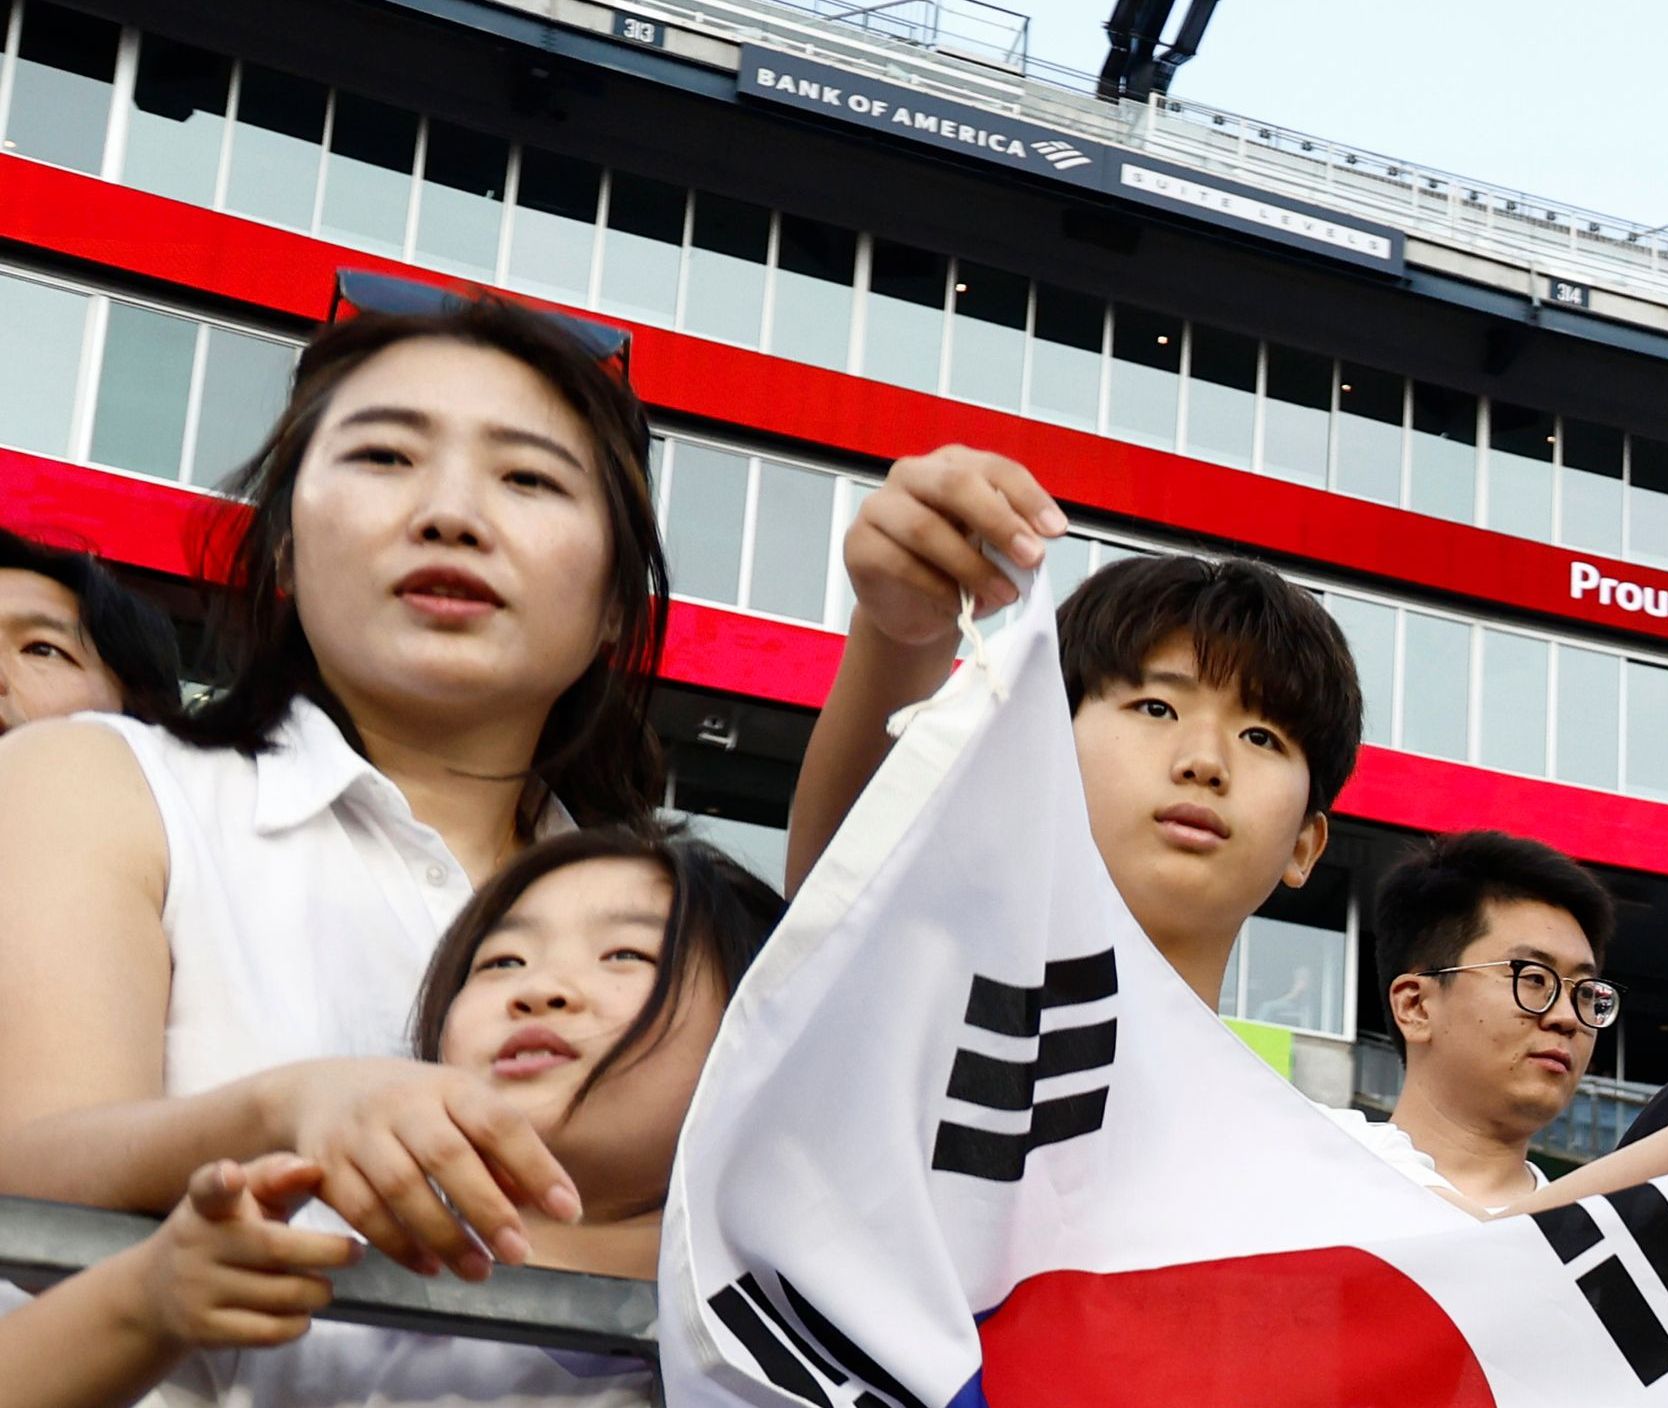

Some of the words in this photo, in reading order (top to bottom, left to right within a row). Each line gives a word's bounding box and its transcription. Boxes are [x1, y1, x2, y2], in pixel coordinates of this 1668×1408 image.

[623, 18, 655, 43] 313
[756, 68, 842, 106] BANK
[847, 94, 888, 117] OF
[892, 107, 1027, 158] AMERICA
[1131, 172, 1232, 208] SUITE
[1258, 208, 1380, 251] LEVELS
[1556, 283, 1582, 304] 314
